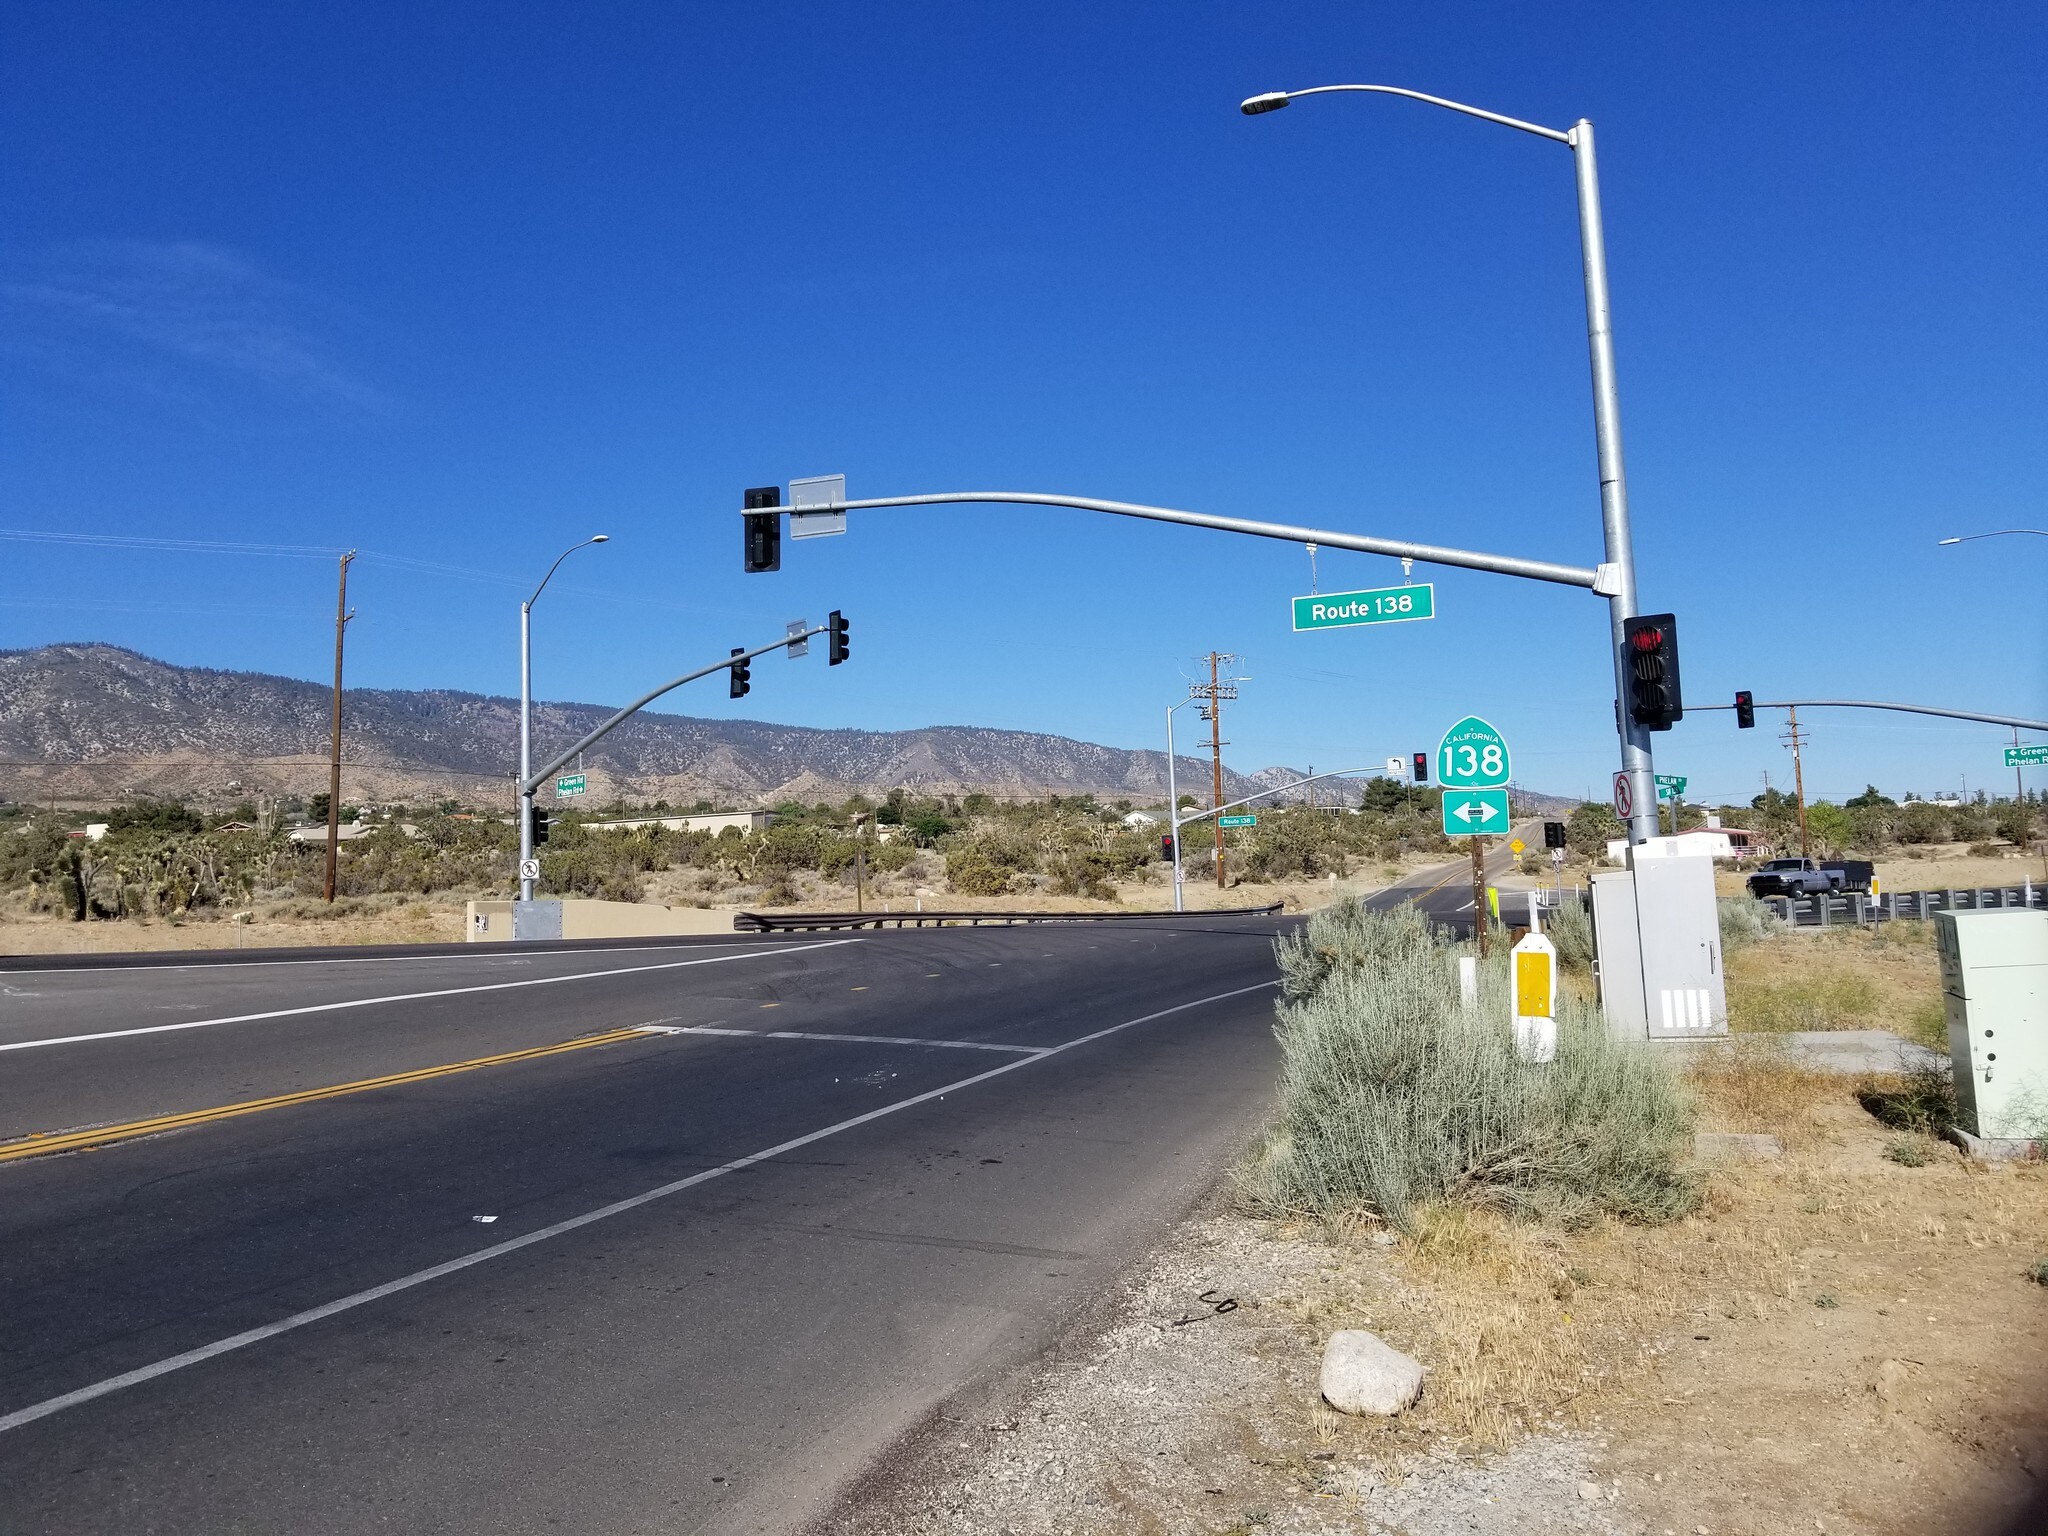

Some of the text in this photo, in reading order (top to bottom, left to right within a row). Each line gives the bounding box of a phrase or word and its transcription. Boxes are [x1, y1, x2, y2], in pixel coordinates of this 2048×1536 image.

[1312, 594, 1413, 621] Route 138
[1445, 732, 1499, 745] CALIFORNIA
[2020, 748, 2048, 756] Green
[1443, 744, 1504, 777] 138
[2008, 755, 2048, 766] Phelan R
[1659, 776, 1677, 785] PHELAN
